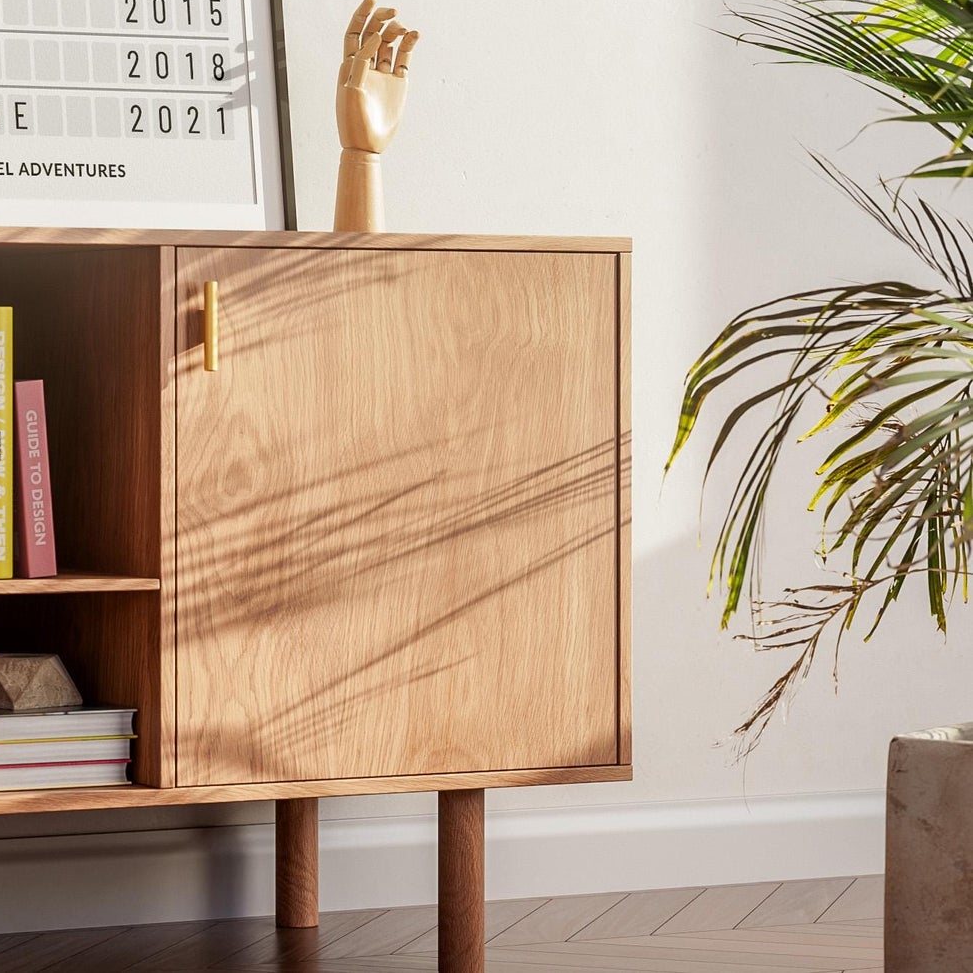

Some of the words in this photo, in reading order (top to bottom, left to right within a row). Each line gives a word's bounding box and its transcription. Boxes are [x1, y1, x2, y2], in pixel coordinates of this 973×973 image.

[127, 50, 225, 82] 2018
[130, 104, 226, 135] 2021
[18, 161, 126, 178] ADVENTURES
[26, 410, 39, 458] GUIDE
[31, 462, 42, 485] TO
[31, 488, 46, 546] DESIGN
